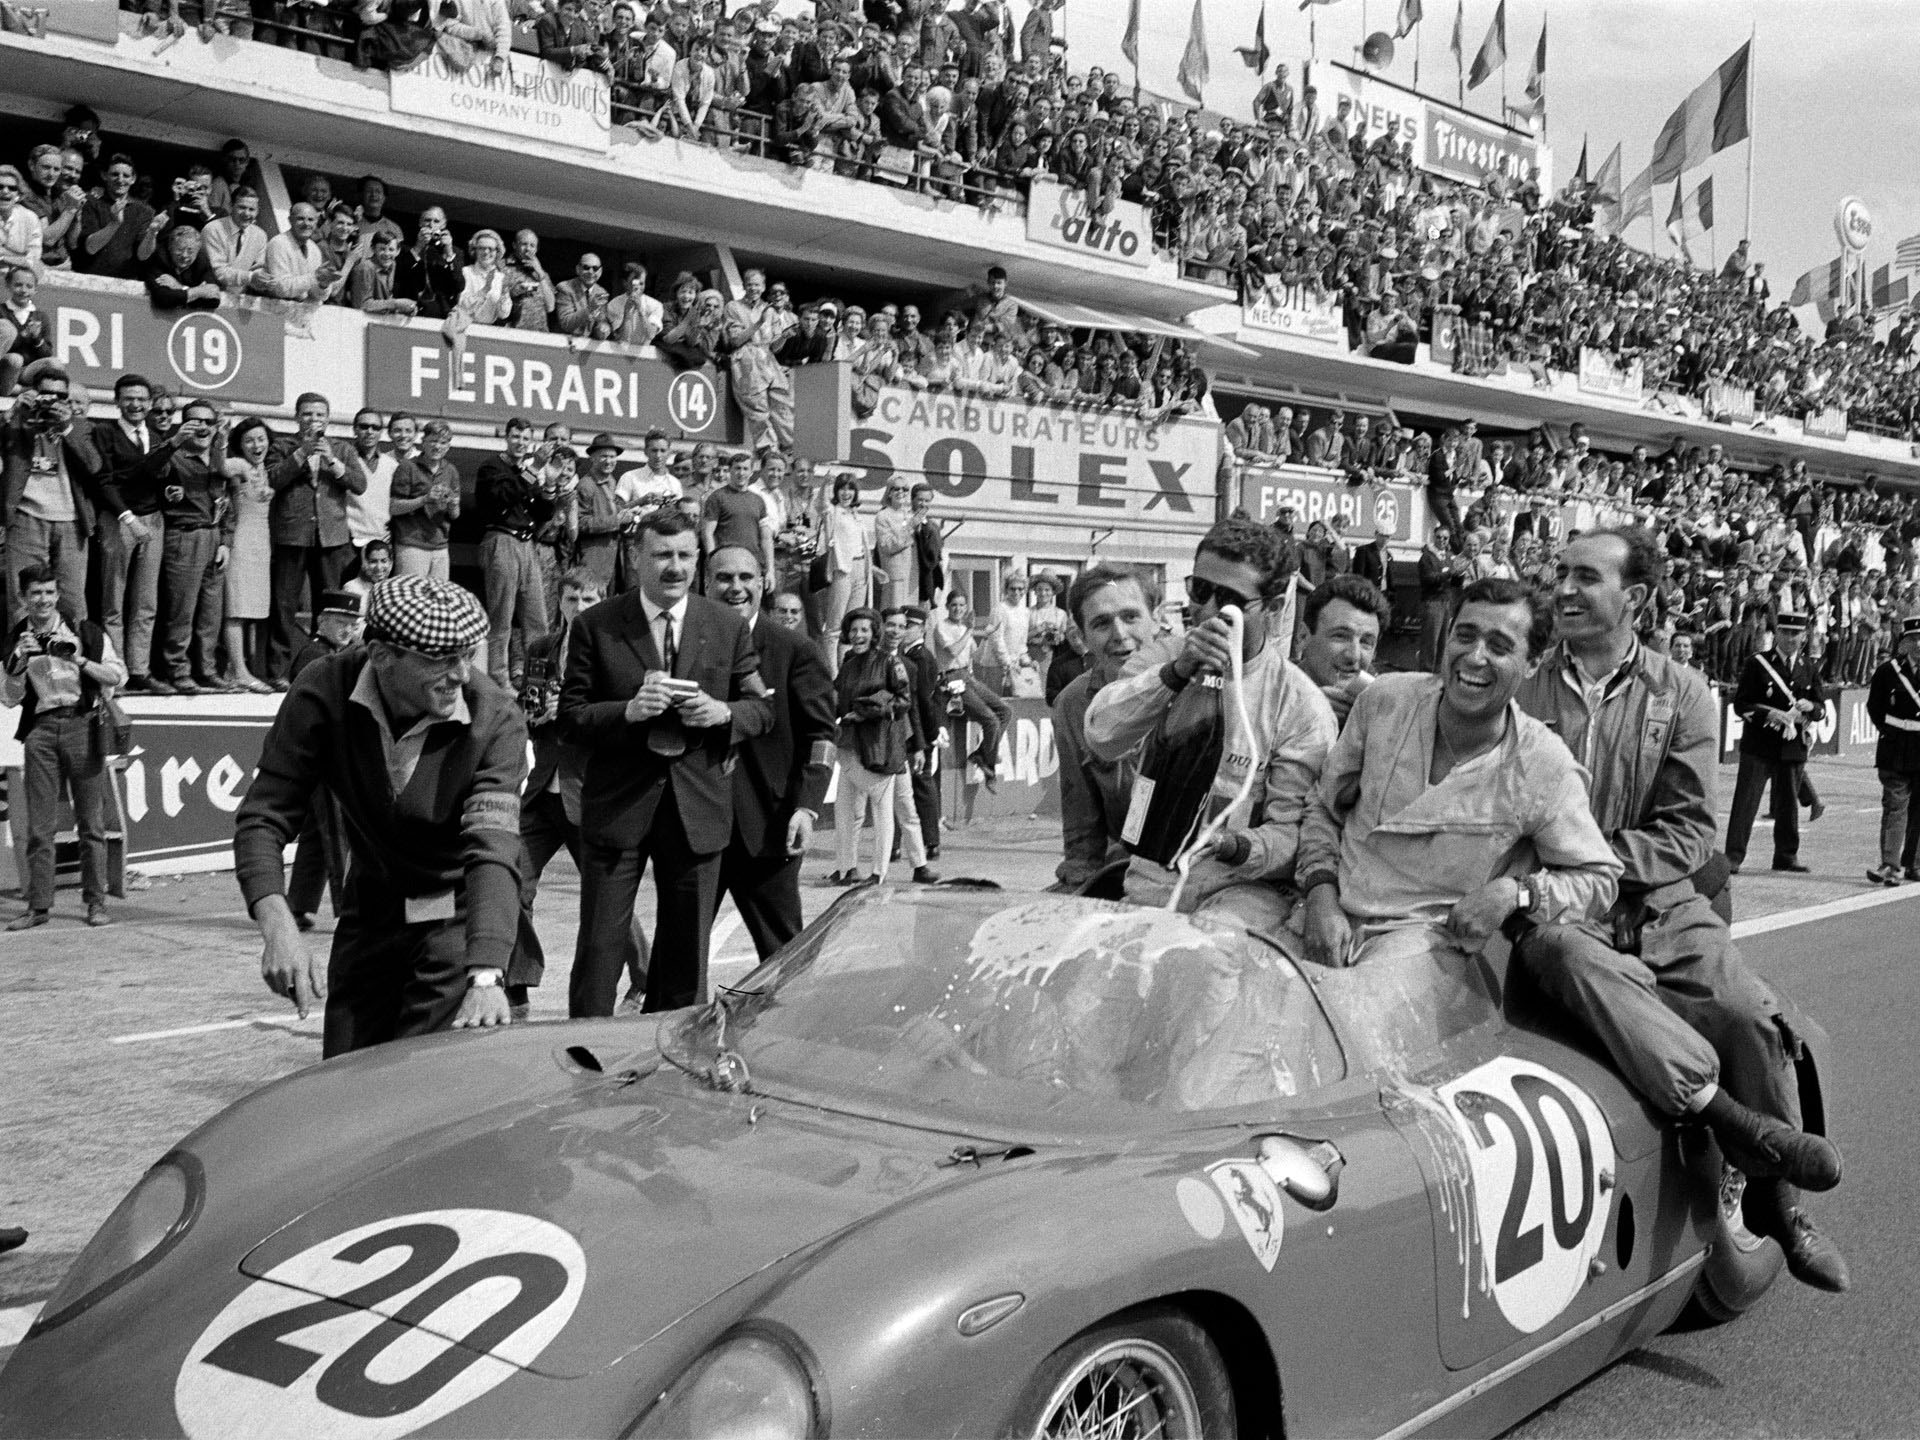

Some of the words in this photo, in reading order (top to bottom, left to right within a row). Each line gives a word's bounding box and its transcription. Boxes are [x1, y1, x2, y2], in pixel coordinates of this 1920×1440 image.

[450, 92, 531, 122] COMPANY
[536, 111, 562, 128] LTD
[1062, 216, 1139, 257] auto
[56, 306, 124, 370] RI
[181, 325, 228, 375] 19
[410, 345, 639, 419] FERRARI
[676, 381, 708, 421] 14
[880, 395, 1160, 453] CARBURATEURS
[849, 427, 1195, 514] SOLEX
[1260, 485, 1362, 527] FERRARI
[1375, 498, 1396, 521] 25
[1201, 674, 1224, 690] MO
[113, 744, 260, 823] ire
[1453, 1073, 1595, 1286] 20
[199, 1222, 570, 1419] 20
